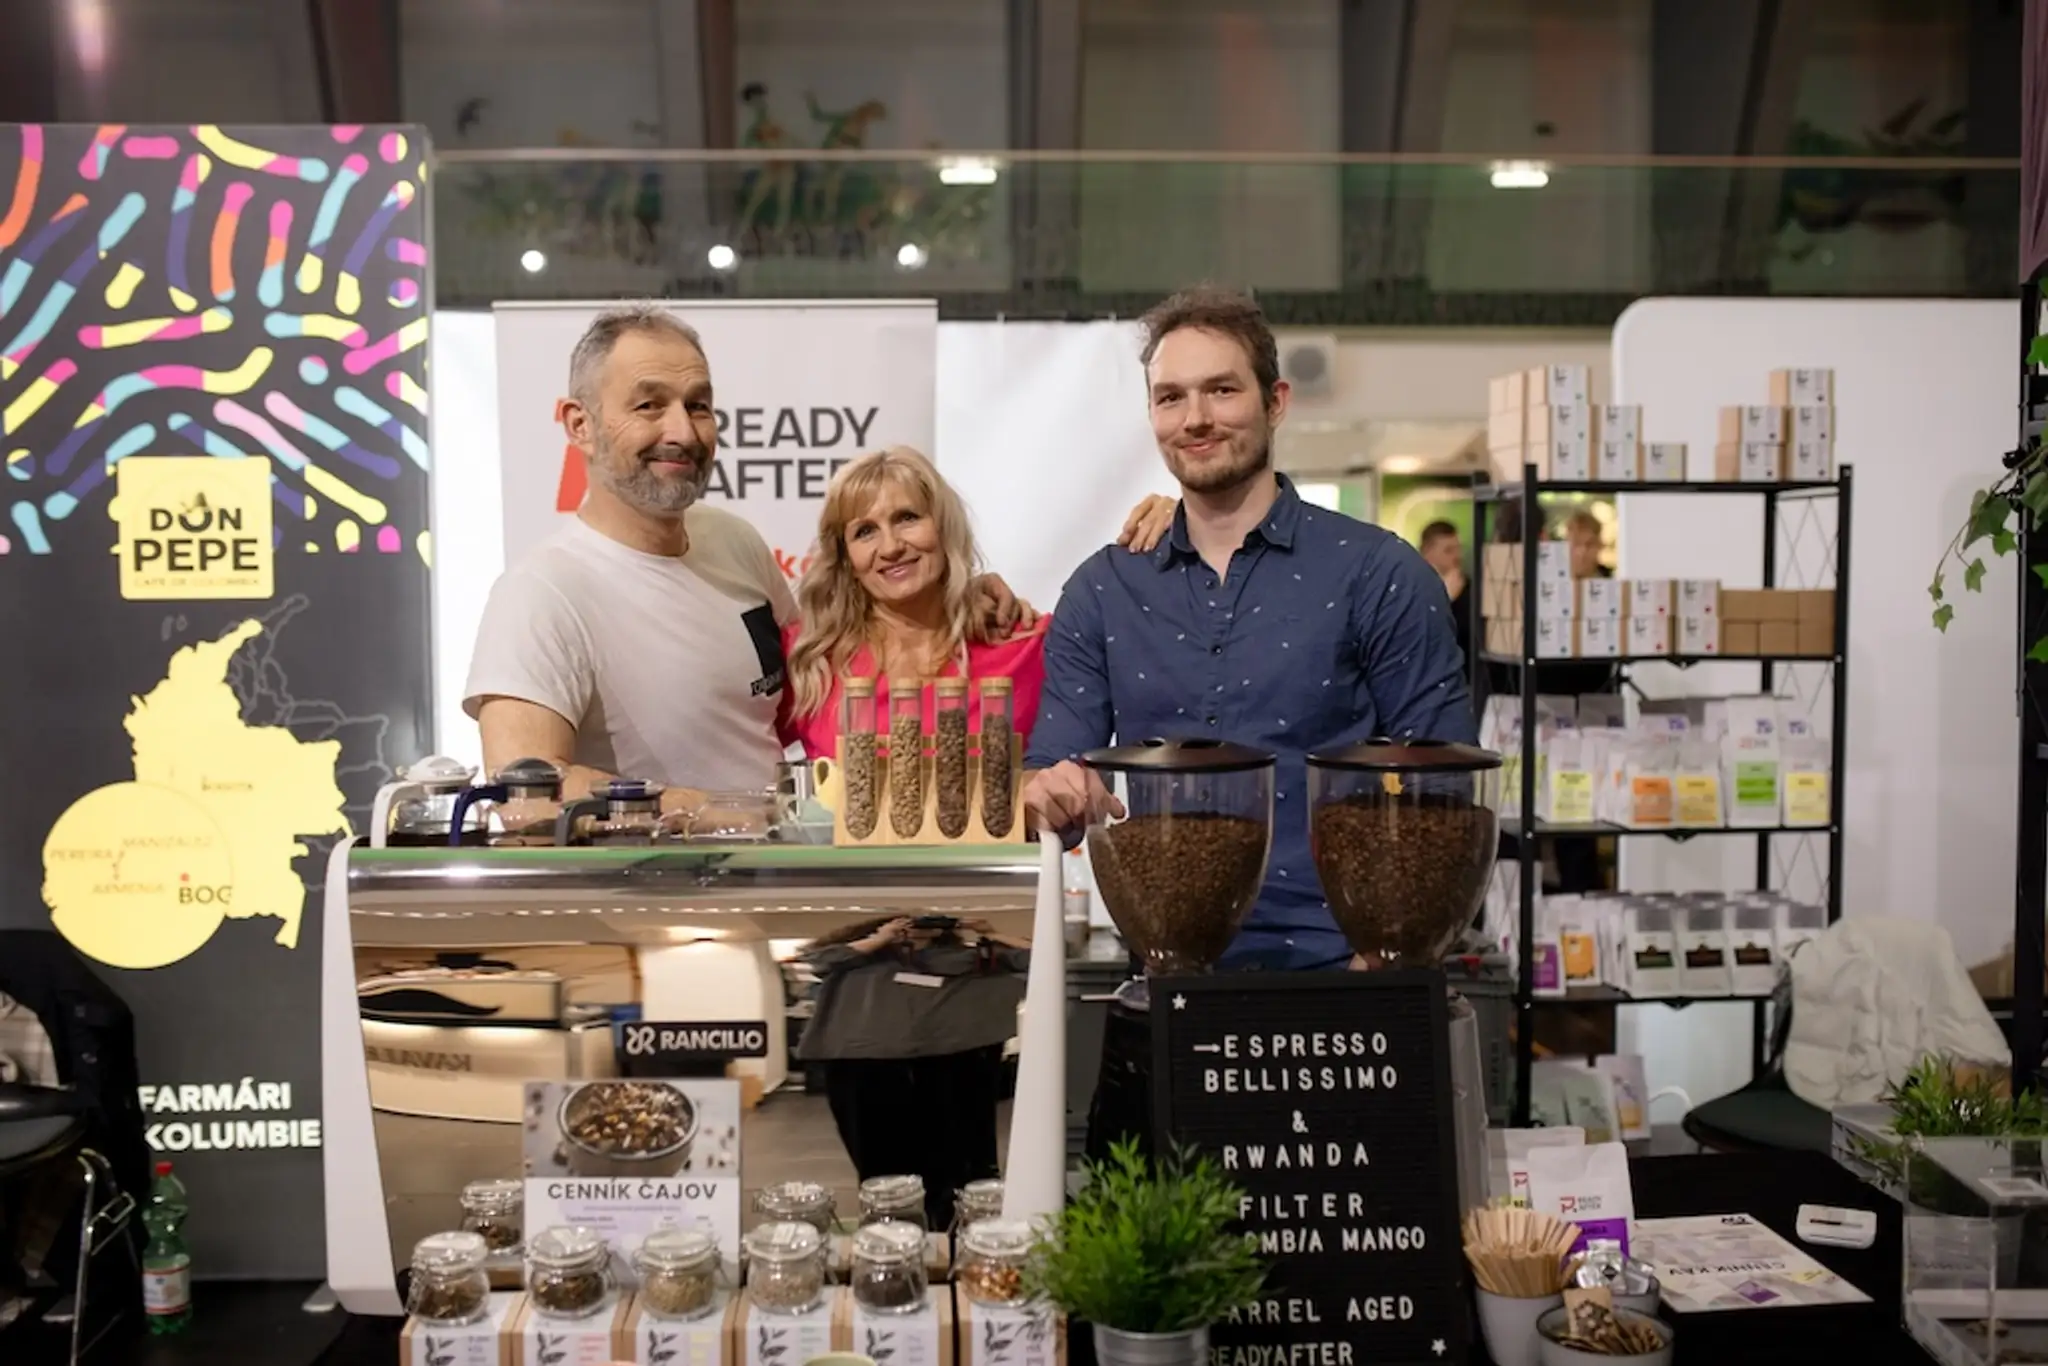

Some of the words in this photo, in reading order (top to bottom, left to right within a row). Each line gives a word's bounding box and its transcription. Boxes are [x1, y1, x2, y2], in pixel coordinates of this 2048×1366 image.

[150, 506, 242, 533] DON
[133, 538, 259, 572] PEPE
[660, 1030, 764, 1050] RANCILIO
[1224, 1032, 1388, 1058] ESPRESSO
[1204, 1064, 1398, 1093] BELLISSIMO
[137, 1076, 291, 1112] FARMÁRI
[1292, 1109, 1309, 1133] &
[1223, 1141, 1370, 1170] RWANDA
[548, 1177, 631, 1200] CENNÍK
[638, 1177, 718, 1200] ČAJOV
[1238, 1192, 1365, 1220] FILTER
[1341, 1226, 1426, 1251] MANGO
[1346, 1295, 1415, 1322] AGED
